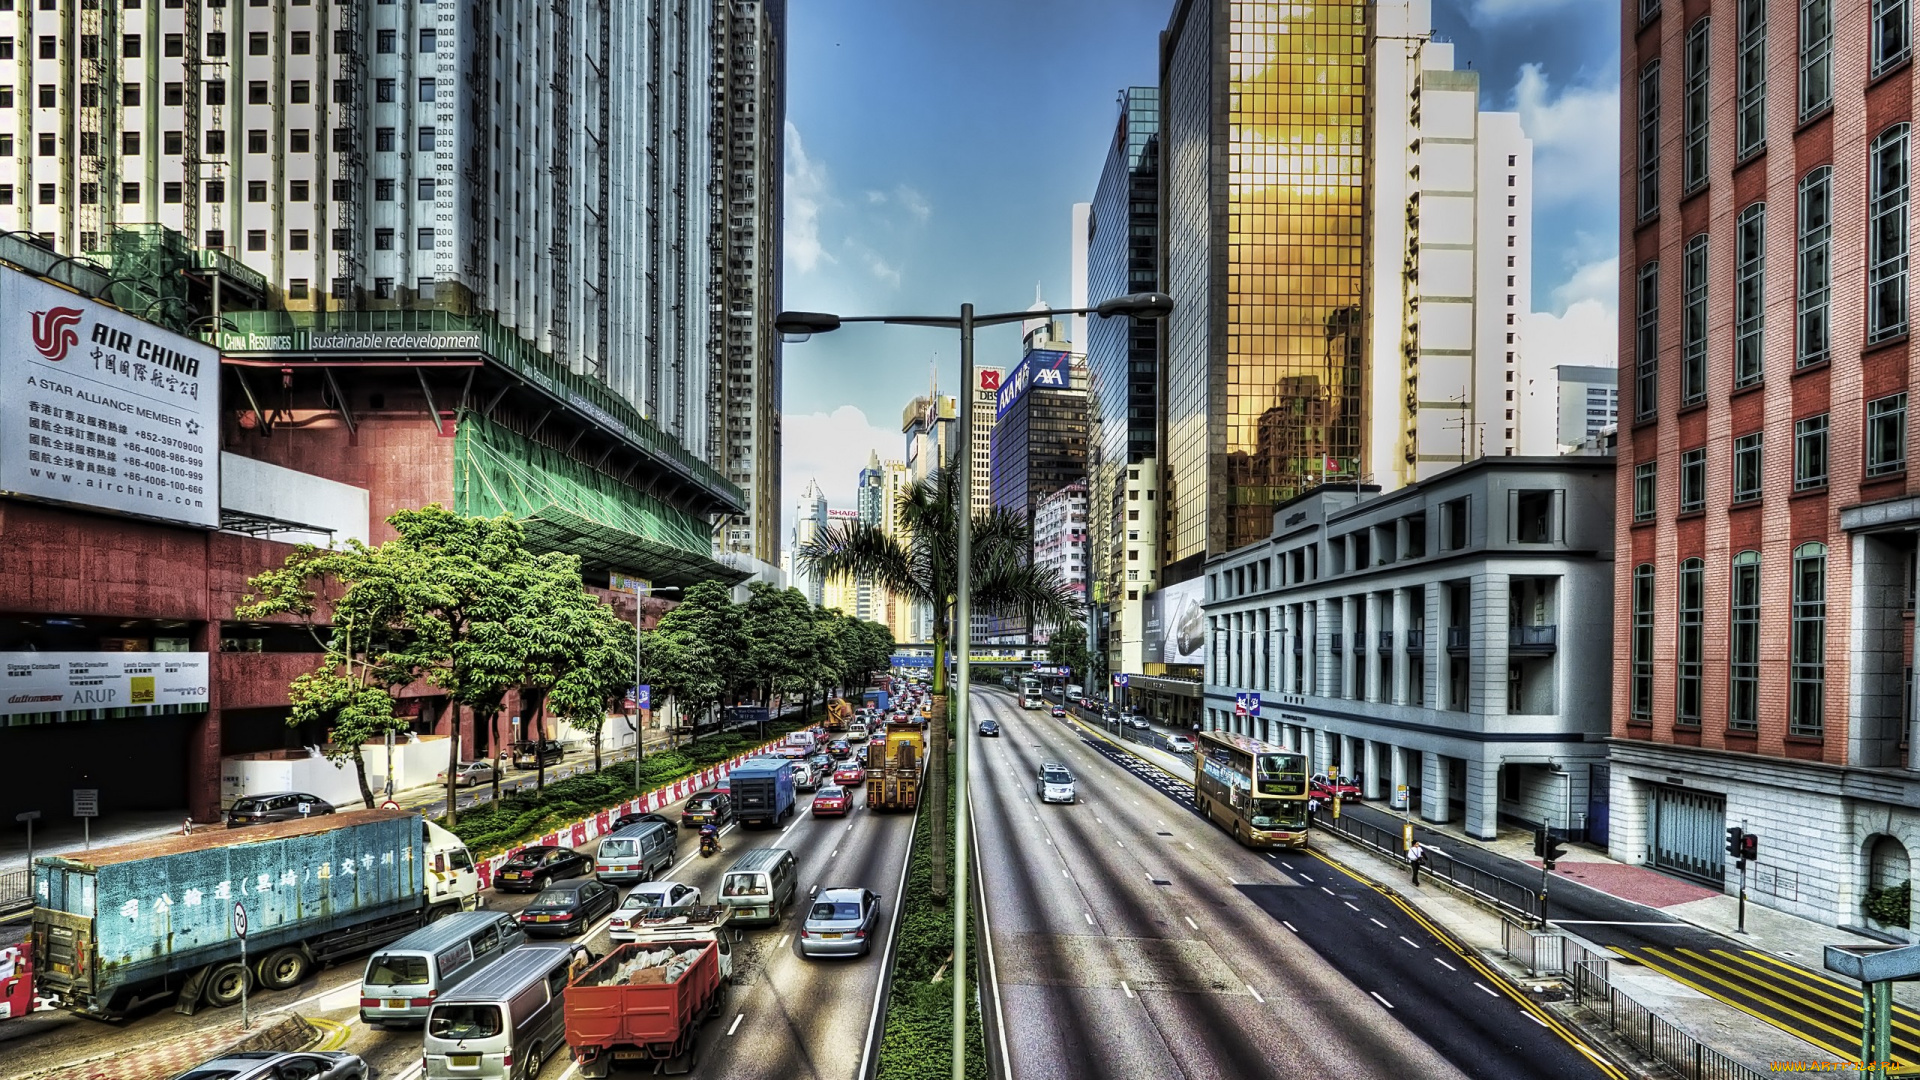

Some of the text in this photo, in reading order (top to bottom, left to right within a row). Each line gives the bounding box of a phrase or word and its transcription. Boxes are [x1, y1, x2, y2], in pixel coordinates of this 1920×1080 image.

[230, 258, 264, 291] RESOURCES
[91, 322, 200, 378] AIR CHINA
[223, 333, 292, 351] CHINA RESOURCES
[312, 333, 480, 350] sustainable redevelopment
[1033, 368, 1063, 385] AXA
[27, 376, 182, 428] A STAR ALLIANCE MEMBER
[998, 381, 1015, 414] AXA
[29, 416, 204, 468] 國航全球訂票熱線 +86-4008-986-999
[134, 429, 204, 454] +852-39709000
[29, 449, 204, 495] 國航全球會員熱線 +86-4006-100-666
[123, 457, 204, 481] +86-4008-100-999
[7, 663, 31, 671] Signage
[73, 688, 116, 704] ARUP
[236, 910, 244, 929] 70
